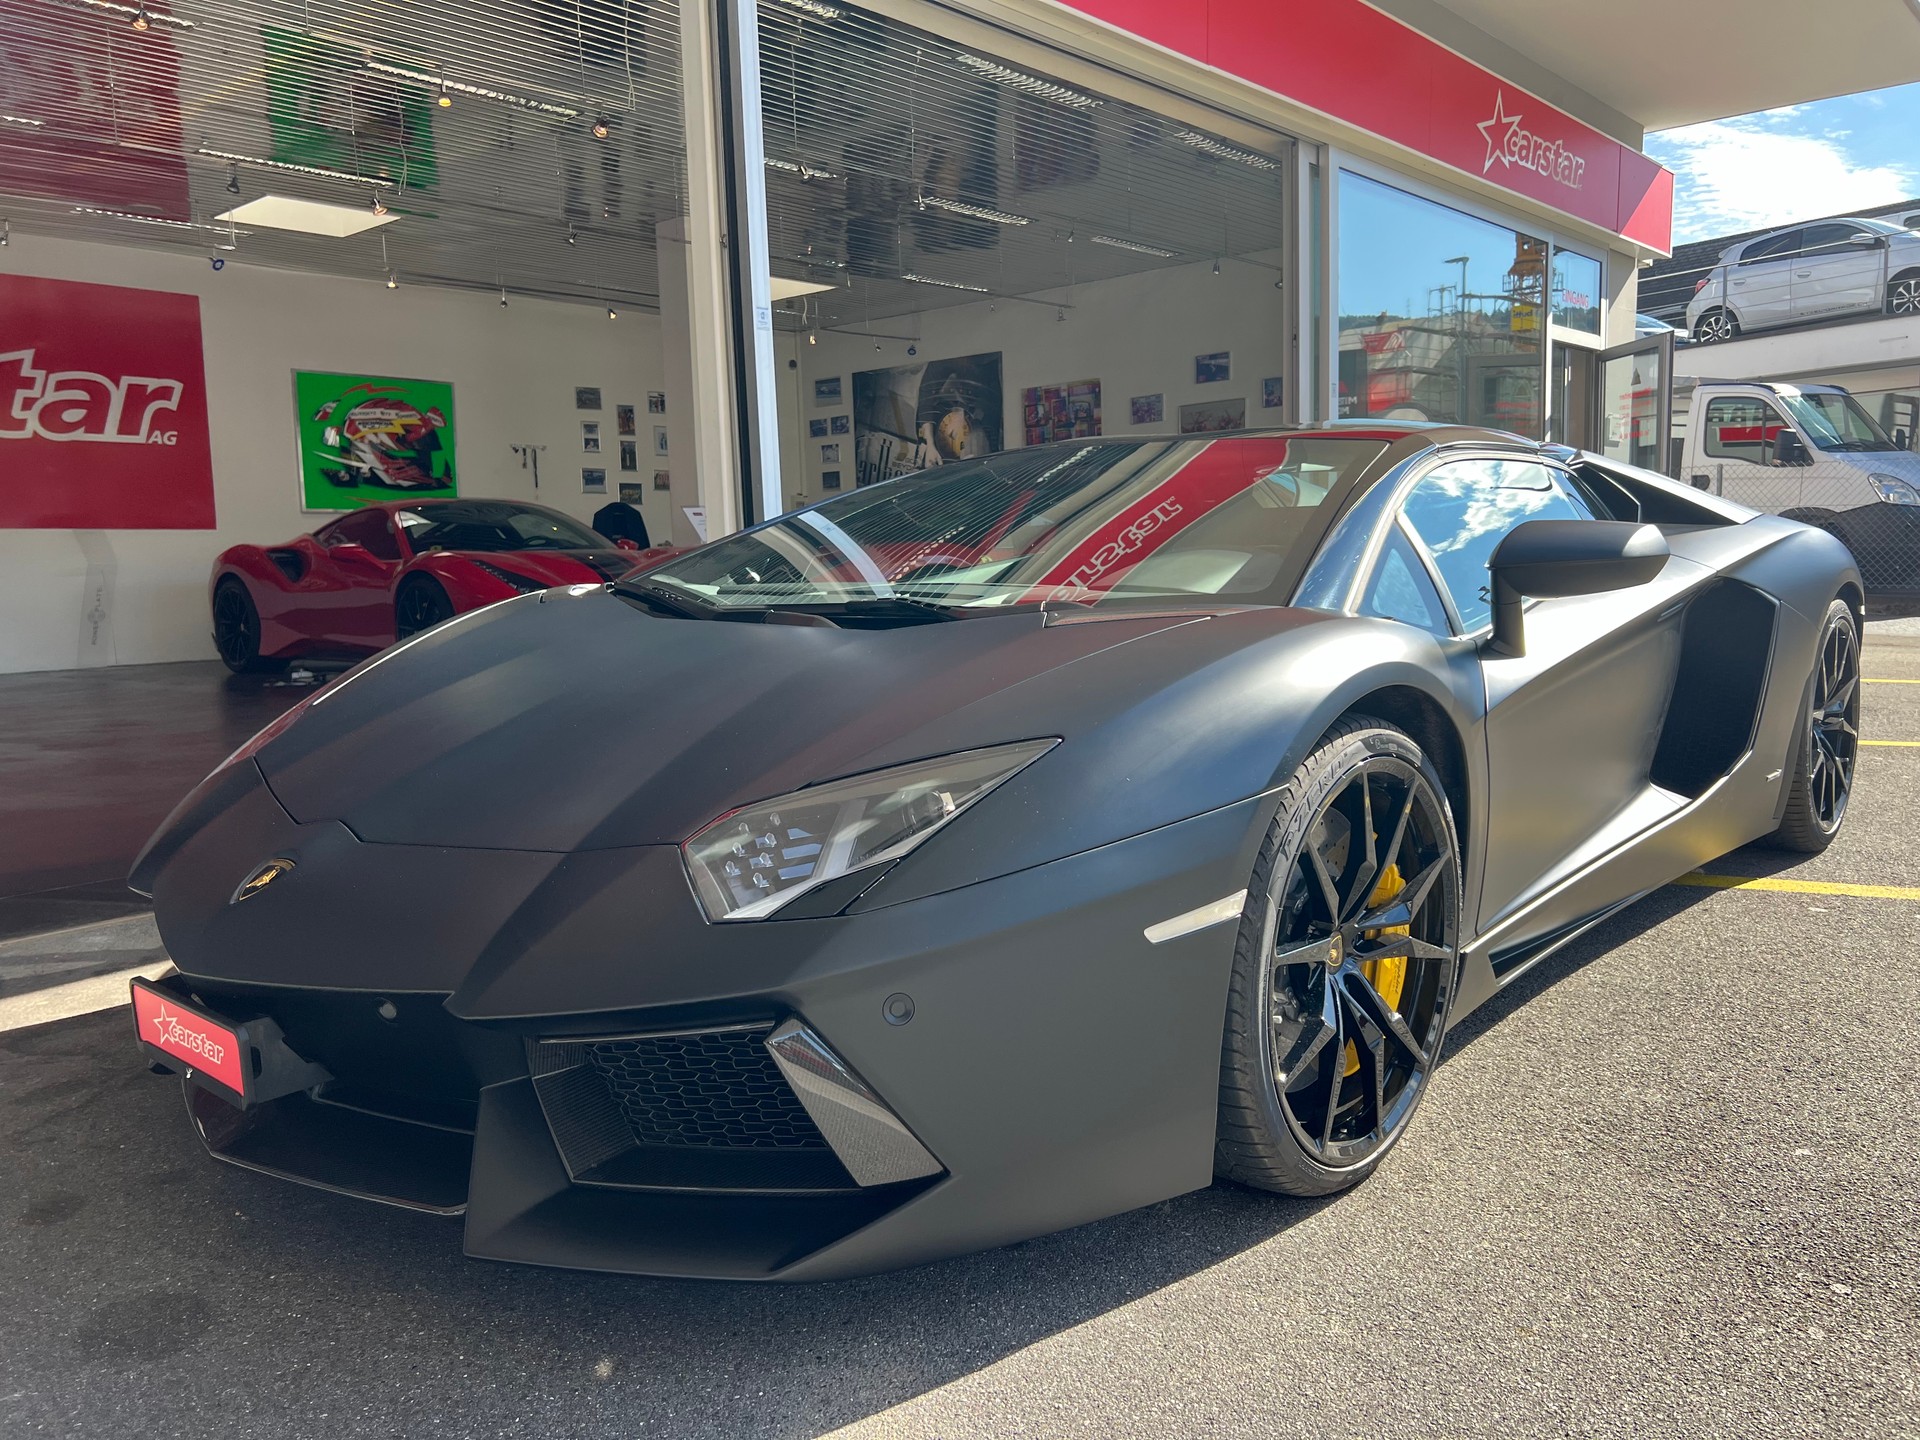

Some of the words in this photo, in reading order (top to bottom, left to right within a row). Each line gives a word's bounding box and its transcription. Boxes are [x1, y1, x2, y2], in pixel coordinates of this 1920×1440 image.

[1504, 124, 1585, 189] carstar
[1562, 289, 1589, 308] EINGANG
[147, 430, 178, 446] AG
[169, 1022, 225, 1064] carstar
